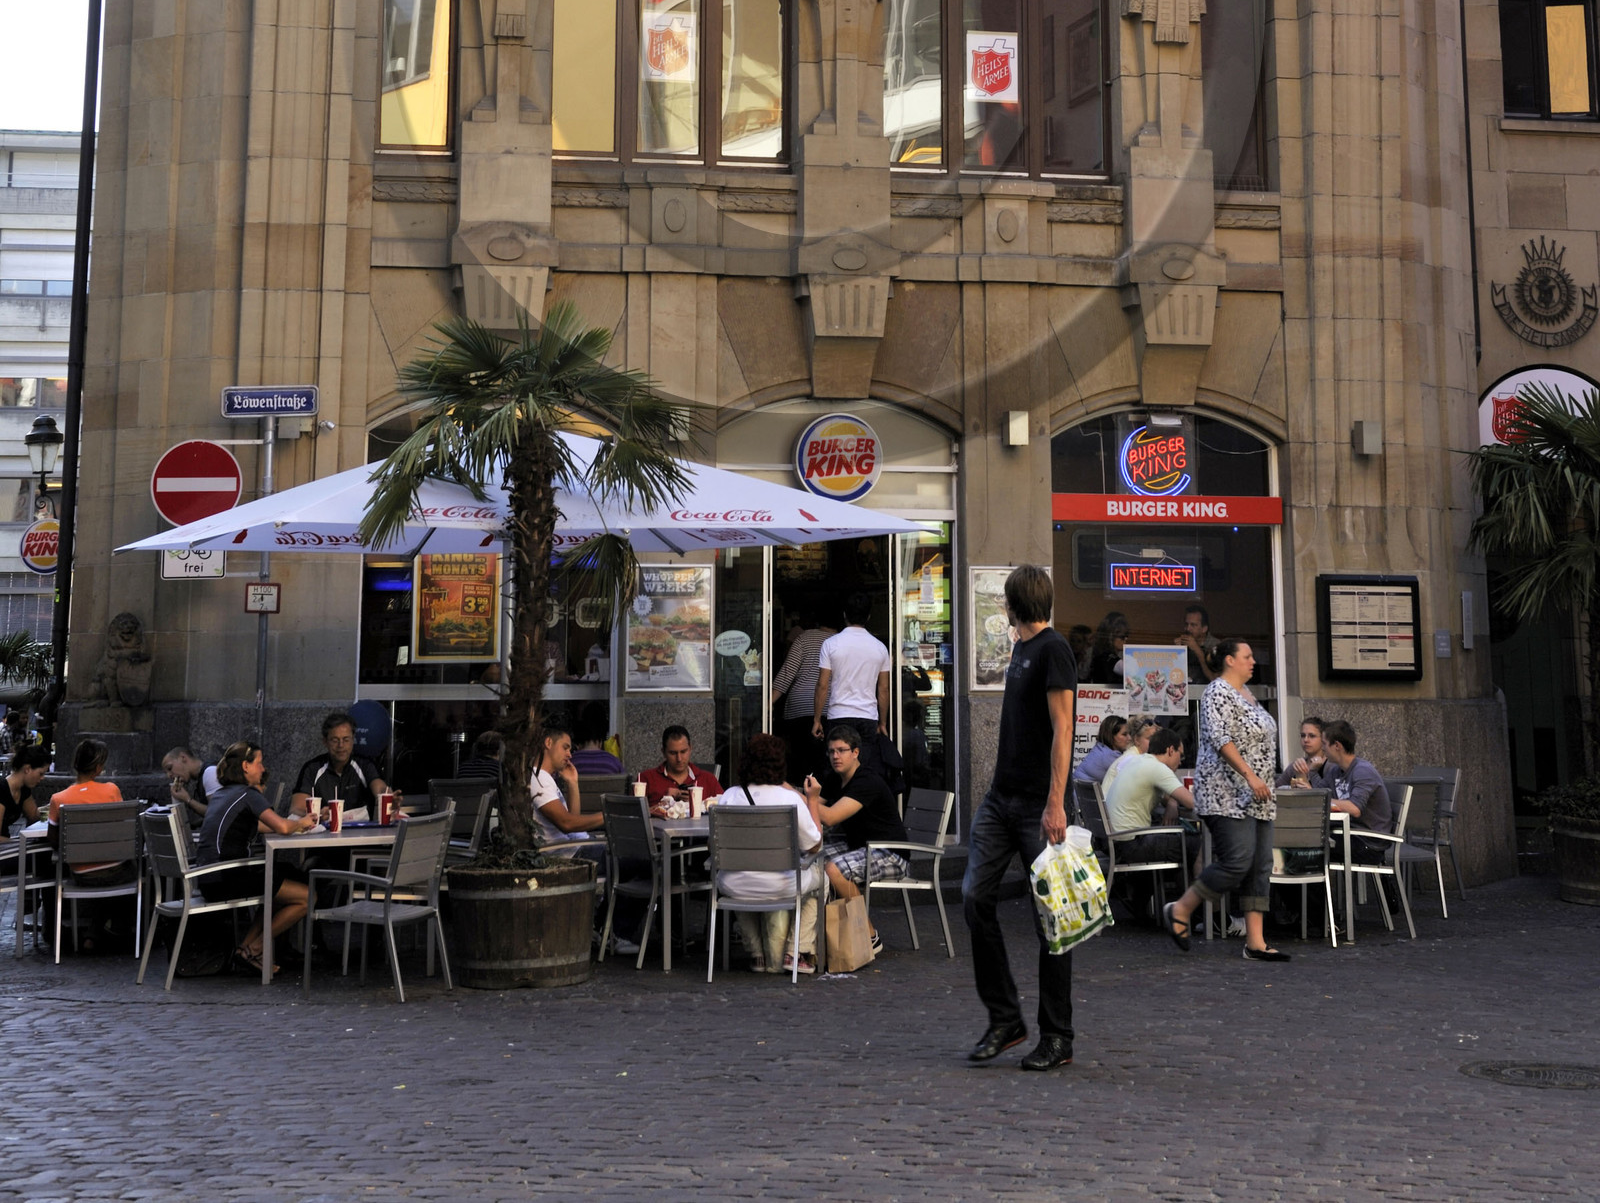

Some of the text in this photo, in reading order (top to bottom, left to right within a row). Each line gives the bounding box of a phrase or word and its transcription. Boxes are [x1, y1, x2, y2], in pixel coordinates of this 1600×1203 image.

[977, 55, 986, 66] DIE
[977, 56, 1006, 79] HEILS-
[983, 65, 1009, 89] ARMEE
[807, 438, 876, 457] BURGER
[1128, 436, 1186, 465] BURGER
[805, 453, 876, 479] KING
[1132, 451, 1187, 483] KING
[1106, 500, 1229, 519] BURGER KING
[25, 531, 60, 544] BURG
[22, 541, 60, 558] KIN
[184, 562, 204, 573] frei
[431, 563, 487, 575] MONATS
[643, 572, 695, 582] WHOPPER
[1114, 567, 1193, 587] INTERNET
[643, 581, 697, 593] WEEKS
[1077, 689, 1112, 700] BANG
